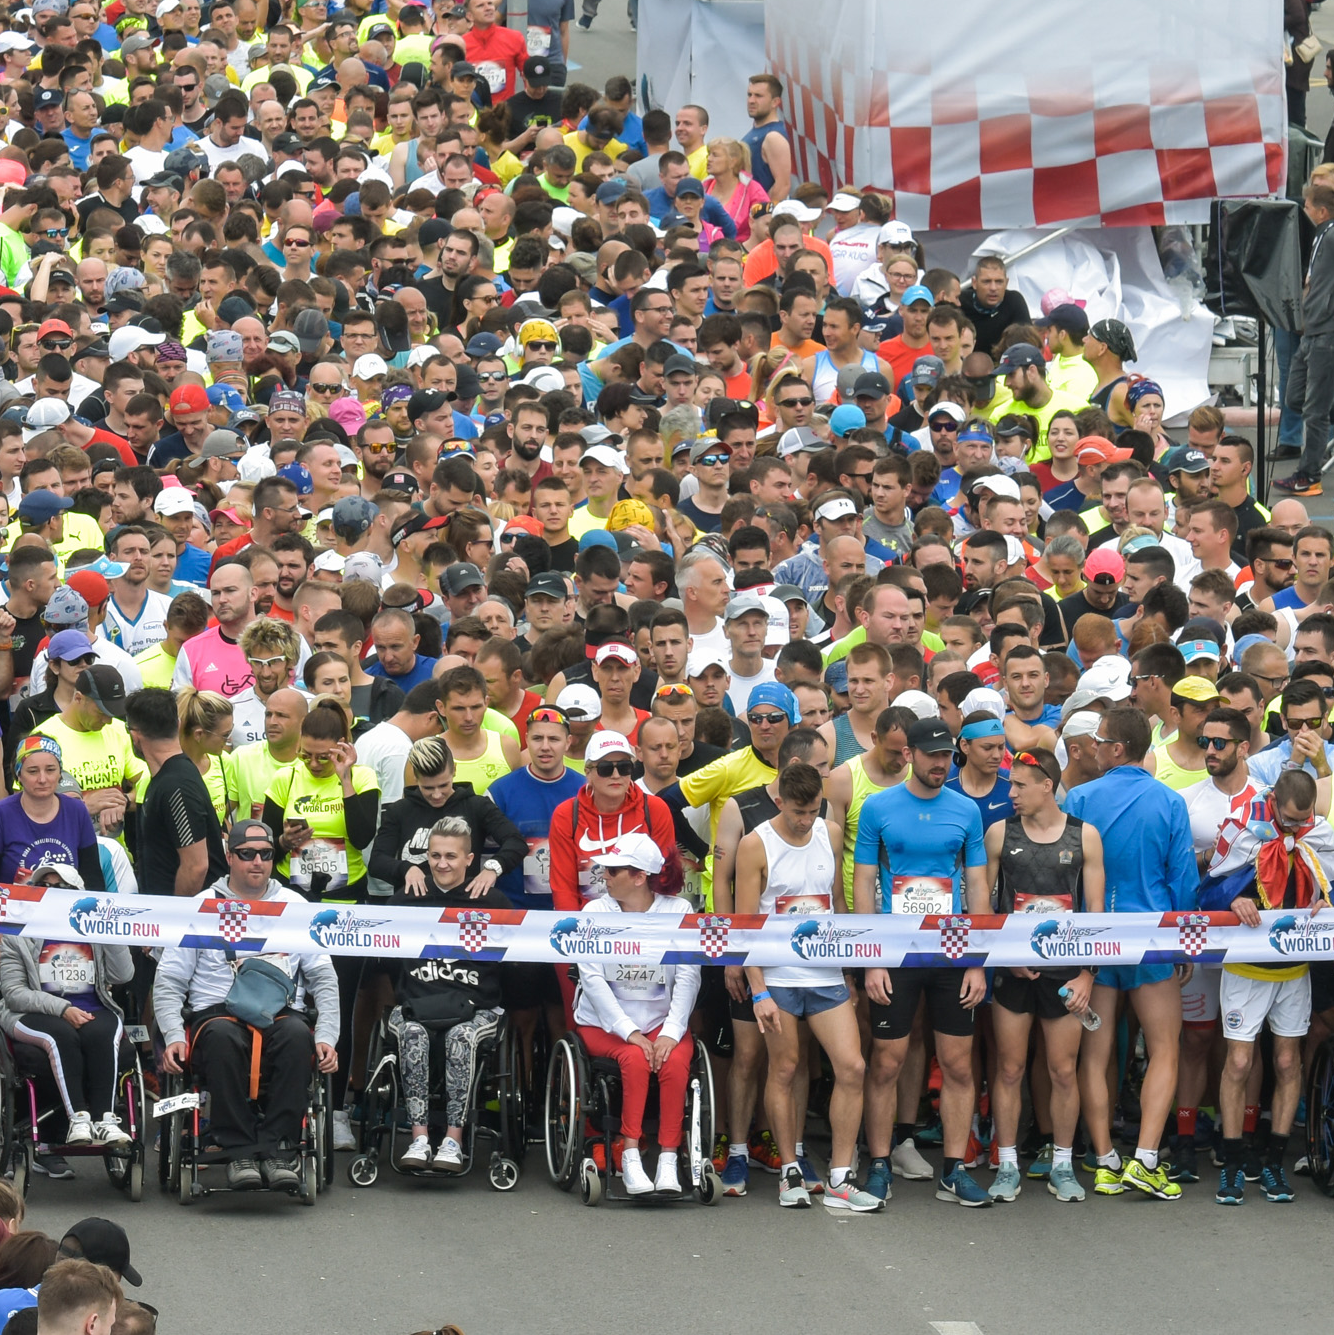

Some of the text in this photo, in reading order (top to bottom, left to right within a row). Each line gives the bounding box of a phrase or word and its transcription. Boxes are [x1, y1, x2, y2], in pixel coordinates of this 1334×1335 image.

[303, 802, 329, 813] WORLD
[300, 861, 337, 875] 89505
[903, 902, 942, 915] 56902
[84, 921, 159, 937] WORLD RUN
[324, 932, 401, 949] WORLD RUN
[565, 939, 641, 955] WORLD RUN
[1284, 937, 1332, 952] WORLD
[807, 943, 881, 958] WORLD RUN
[1045, 941, 1121, 957] WORLD RUN
[51, 969, 87, 981] 11238
[615, 969, 655, 981] 24747
